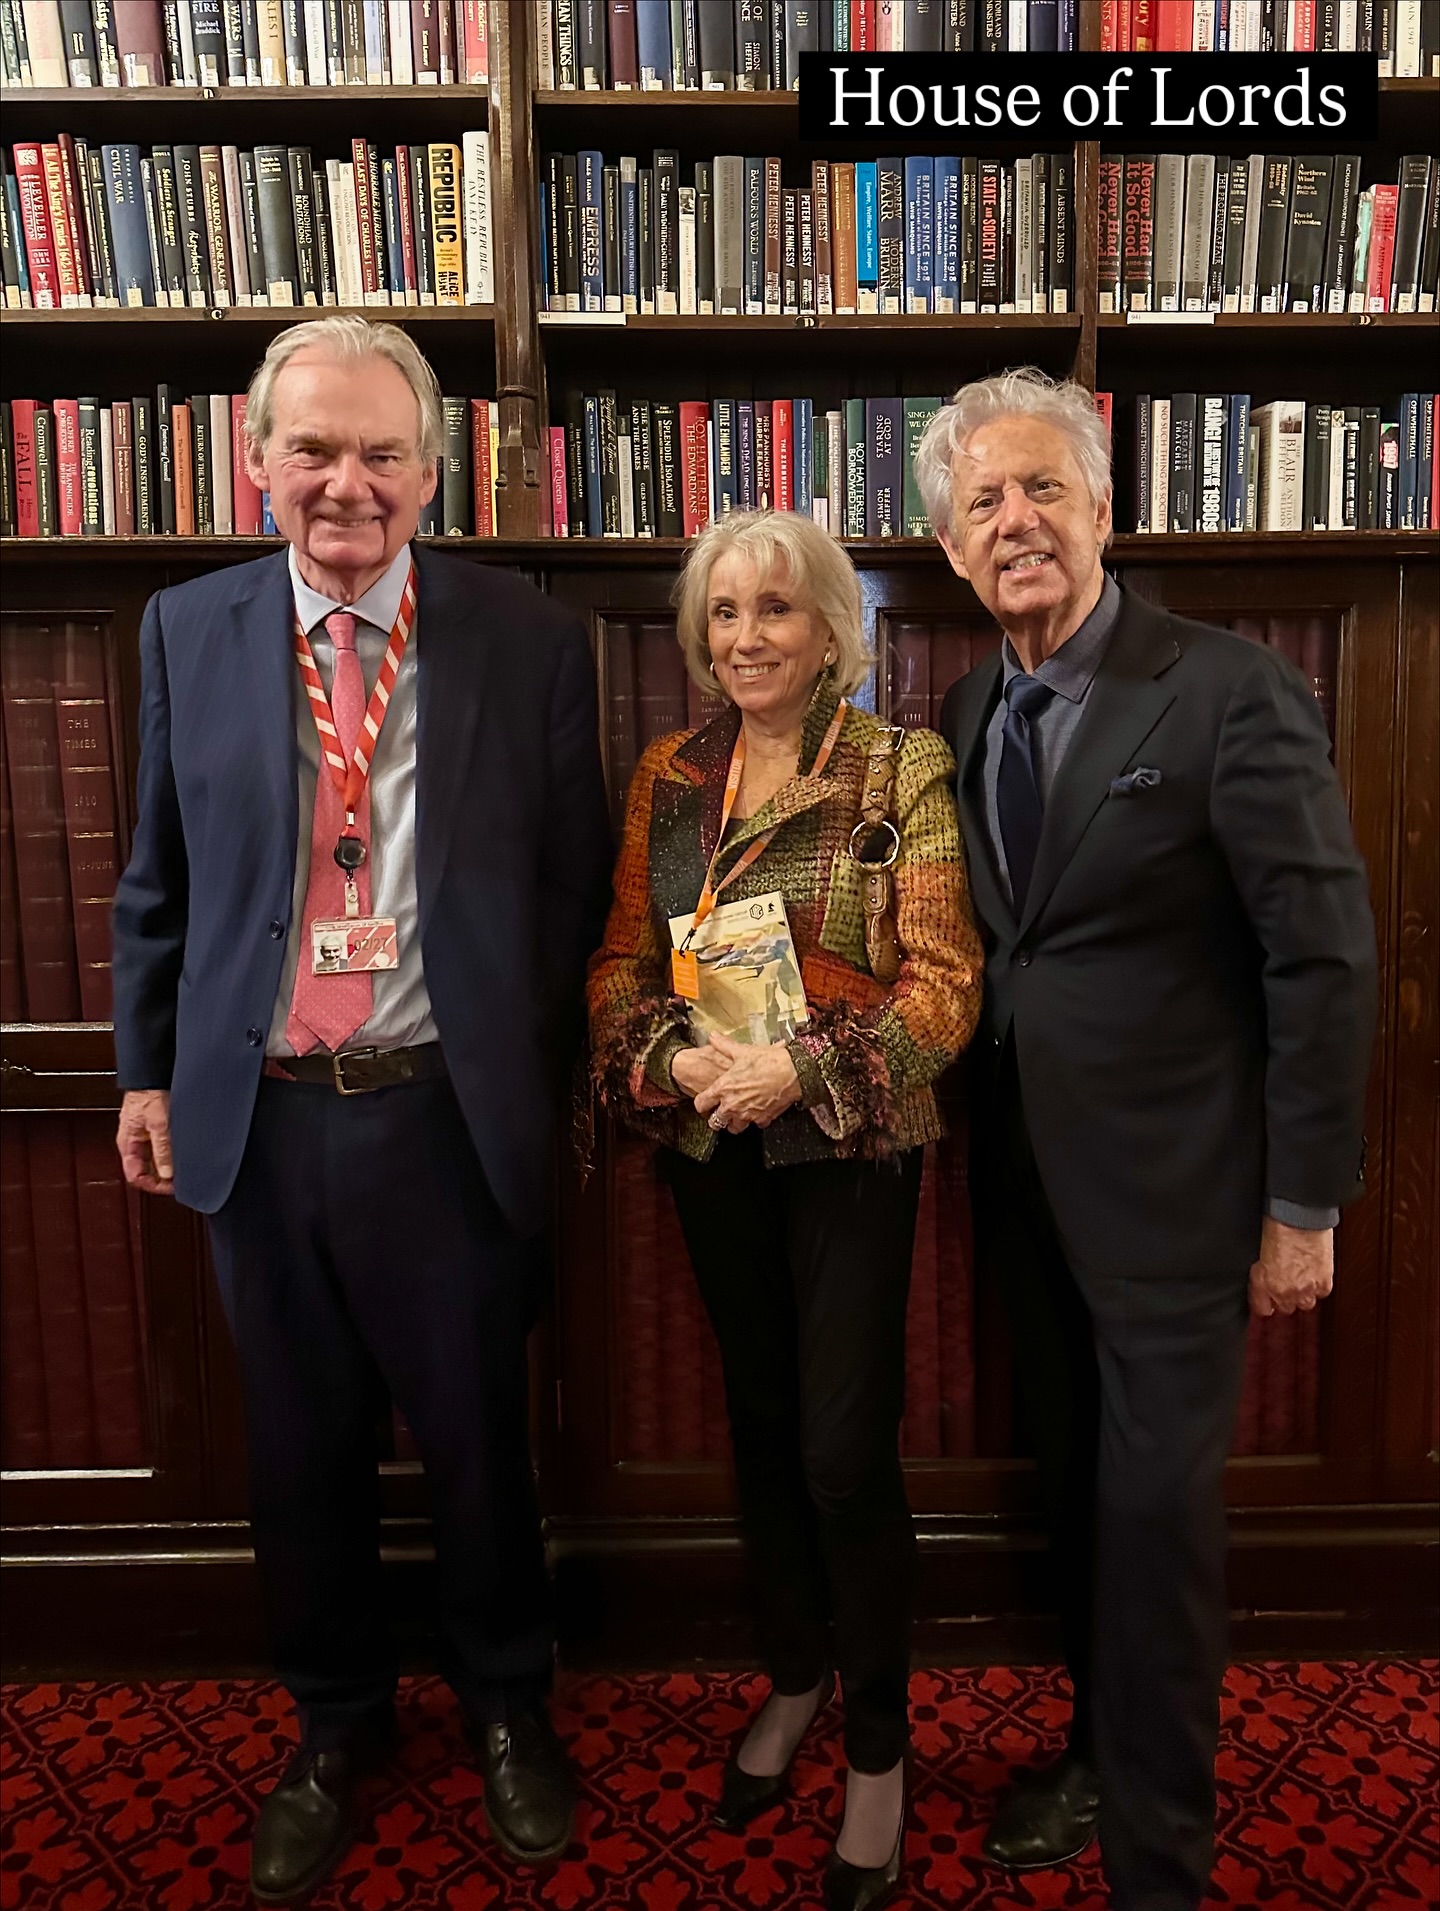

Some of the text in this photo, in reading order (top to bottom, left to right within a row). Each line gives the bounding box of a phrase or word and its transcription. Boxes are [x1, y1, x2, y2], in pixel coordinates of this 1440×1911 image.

[192, 3, 220, 14] FIRE
[230, 5, 242, 40] WARS
[560, 25, 572, 65] THINGS
[110, 150, 124, 204] CIVIL WAR
[162, 169, 172, 200] Soldiers
[182, 160, 195, 222] JOHN STUBBS
[356, 143, 368, 219] THE LAST DAYS OF
[431, 148, 457, 243] REPUBLIC
[477, 169, 486, 220] RESTLESS
[880, 170, 893, 222] MARR
[893, 174, 902, 219] ANDREW
[949, 175, 957, 220] BRITAIN
[21, 181, 35, 240] REVOLUTION
[32, 182, 46, 240] LEVELLER
[46, 160, 73, 286] All The King's Armies 1642-1651
[295, 195, 305, 244] REPUTATIONS
[301, 195, 312, 244] ROUNDHEAD
[750, 169, 759, 254] BALFOUR'S WORLD
[768, 164, 778, 240] PETER HENNESSY
[816, 166, 828, 242] PETER HENNESSY
[982, 176, 997, 260] STATE AND SOCIETY
[1107, 162, 1120, 257] Never Had
[1125, 162, 1141, 257] It So Good
[1140, 162, 1154, 257] Never Had
[1216, 191, 1225, 233] PROFUMO
[166, 210, 176, 247] Strangers
[210, 184, 226, 286] WARRIOR GENERALS
[363, 222, 371, 259] CHARLES
[479, 225, 487, 274] REPUBLIC
[586, 206, 599, 276] EMPRESS
[785, 195, 795, 268] PETER HENNESSY
[800, 195, 812, 267] PETER HENNESSY
[1056, 233, 1064, 264] MINDS
[1214, 235, 1223, 265] AFFAIR
[438, 271, 448, 297] HUNT
[449, 271, 458, 297] ALICE
[880, 238, 890, 289] BRITAIN
[890, 237, 898, 289] MODERN
[921, 262, 930, 282] 1918
[948, 262, 957, 282] 1918
[1161, 406, 1167, 420] NO
[1204, 398, 1222, 440] BANG!
[37, 417, 48, 466] Cromwell
[85, 429, 94, 466] Reading
[197, 453, 204, 461] OF
[719, 404, 731, 475] LITTLE ENGLANDERS
[884, 443, 891, 454] AT
[1286, 439, 1296, 483] BLAIR
[16, 442, 32, 492] FALL
[139, 436, 149, 529] GOD'S INSTRUMENTS
[553, 438, 565, 504] Closet Queens
[663, 420, 676, 512] SPLENDID ISOLATION?
[686, 424, 697, 513] THE EDWARDIANS
[695, 416, 707, 524] ROY HATTERSLEY
[856, 442, 864, 530] ROY HATTERSLEY
[1160, 481, 1166, 490] AS
[1158, 492, 1166, 529] SOCIETY
[65, 739, 96, 748] TIMES
[68, 719, 89, 729] THE
[354, 938, 388, 951] 02/27
